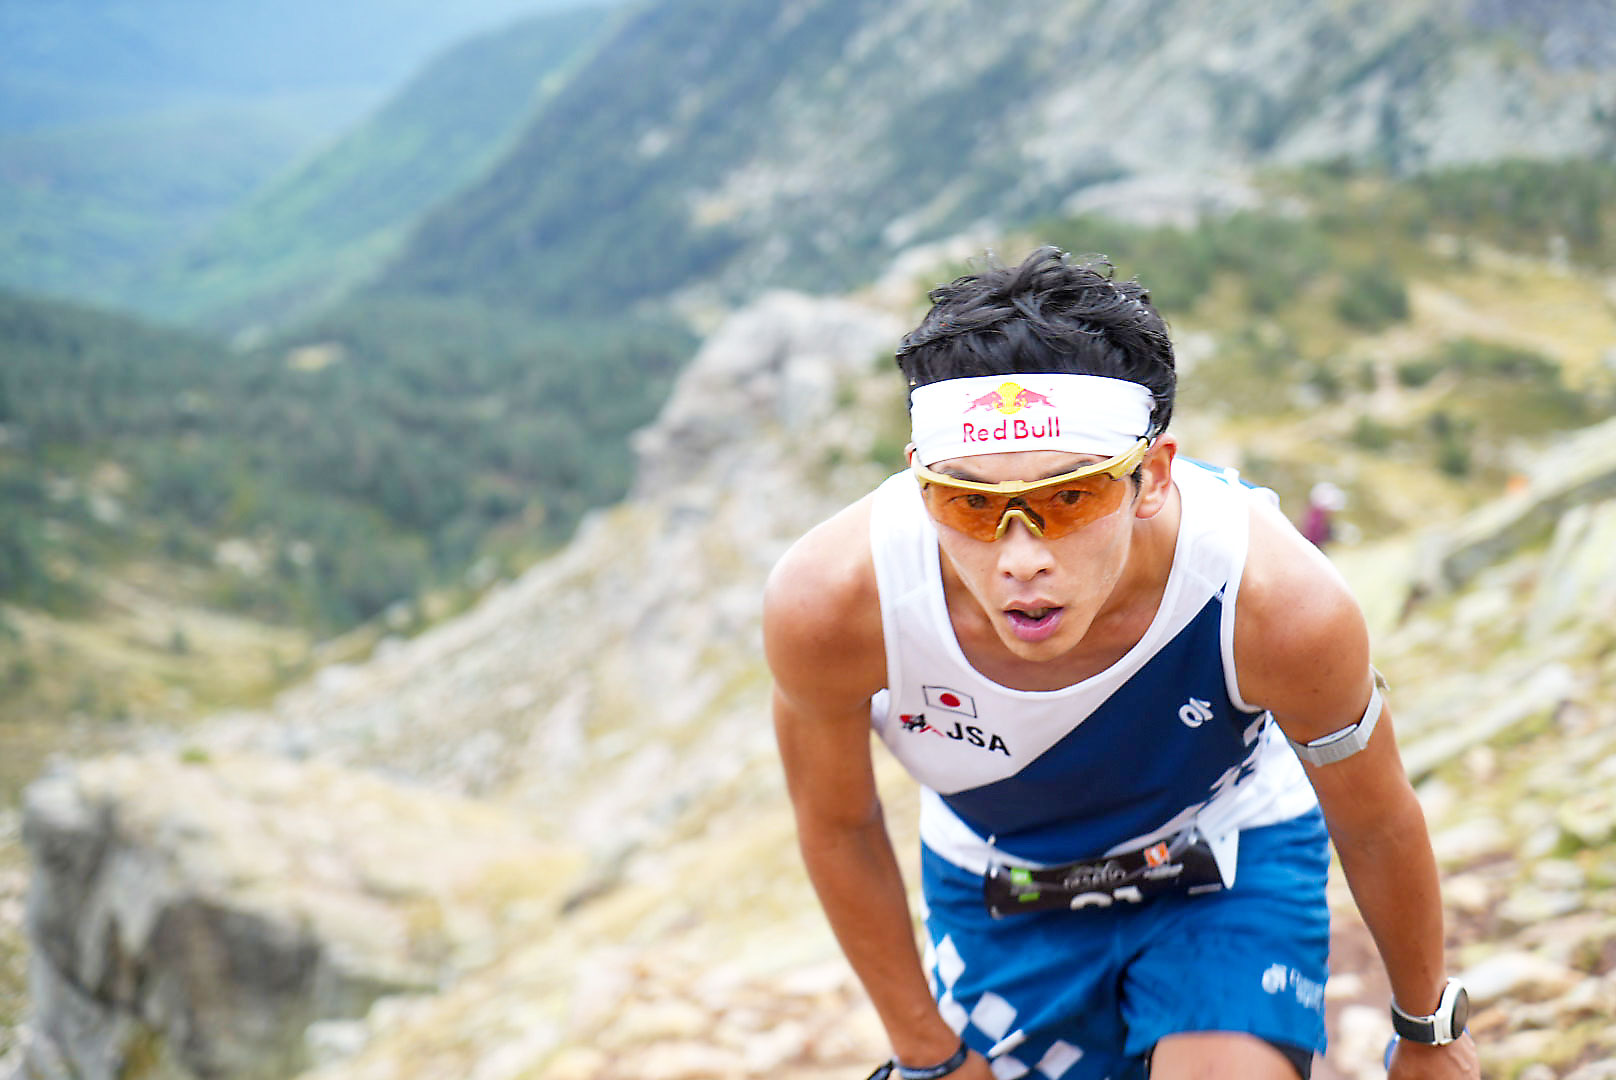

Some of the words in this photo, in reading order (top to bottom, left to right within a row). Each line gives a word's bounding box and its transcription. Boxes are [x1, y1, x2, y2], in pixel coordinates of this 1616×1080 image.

[963, 419, 1007, 443] Red
[1014, 416, 1060, 439] Bull
[946, 721, 1011, 756] JSA
